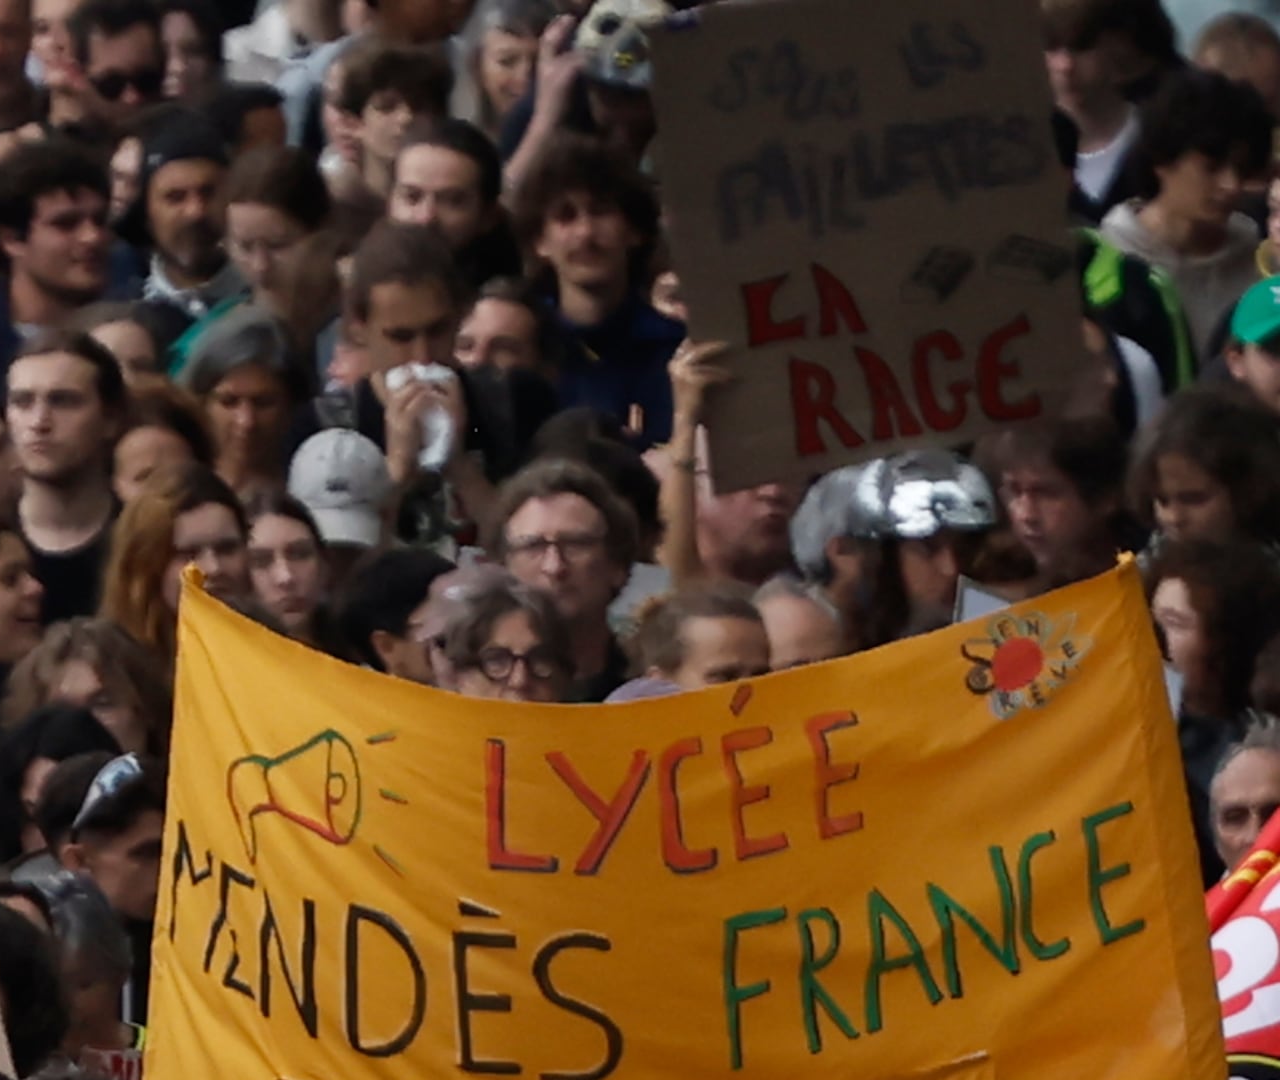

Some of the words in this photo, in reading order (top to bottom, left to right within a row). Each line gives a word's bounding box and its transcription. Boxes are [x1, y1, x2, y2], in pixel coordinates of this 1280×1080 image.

[742, 261, 868, 349] LA
[788, 312, 1042, 458] RAGE
[484, 684, 864, 876] LYCÉE
[722, 799, 1146, 1070] FRANCE
